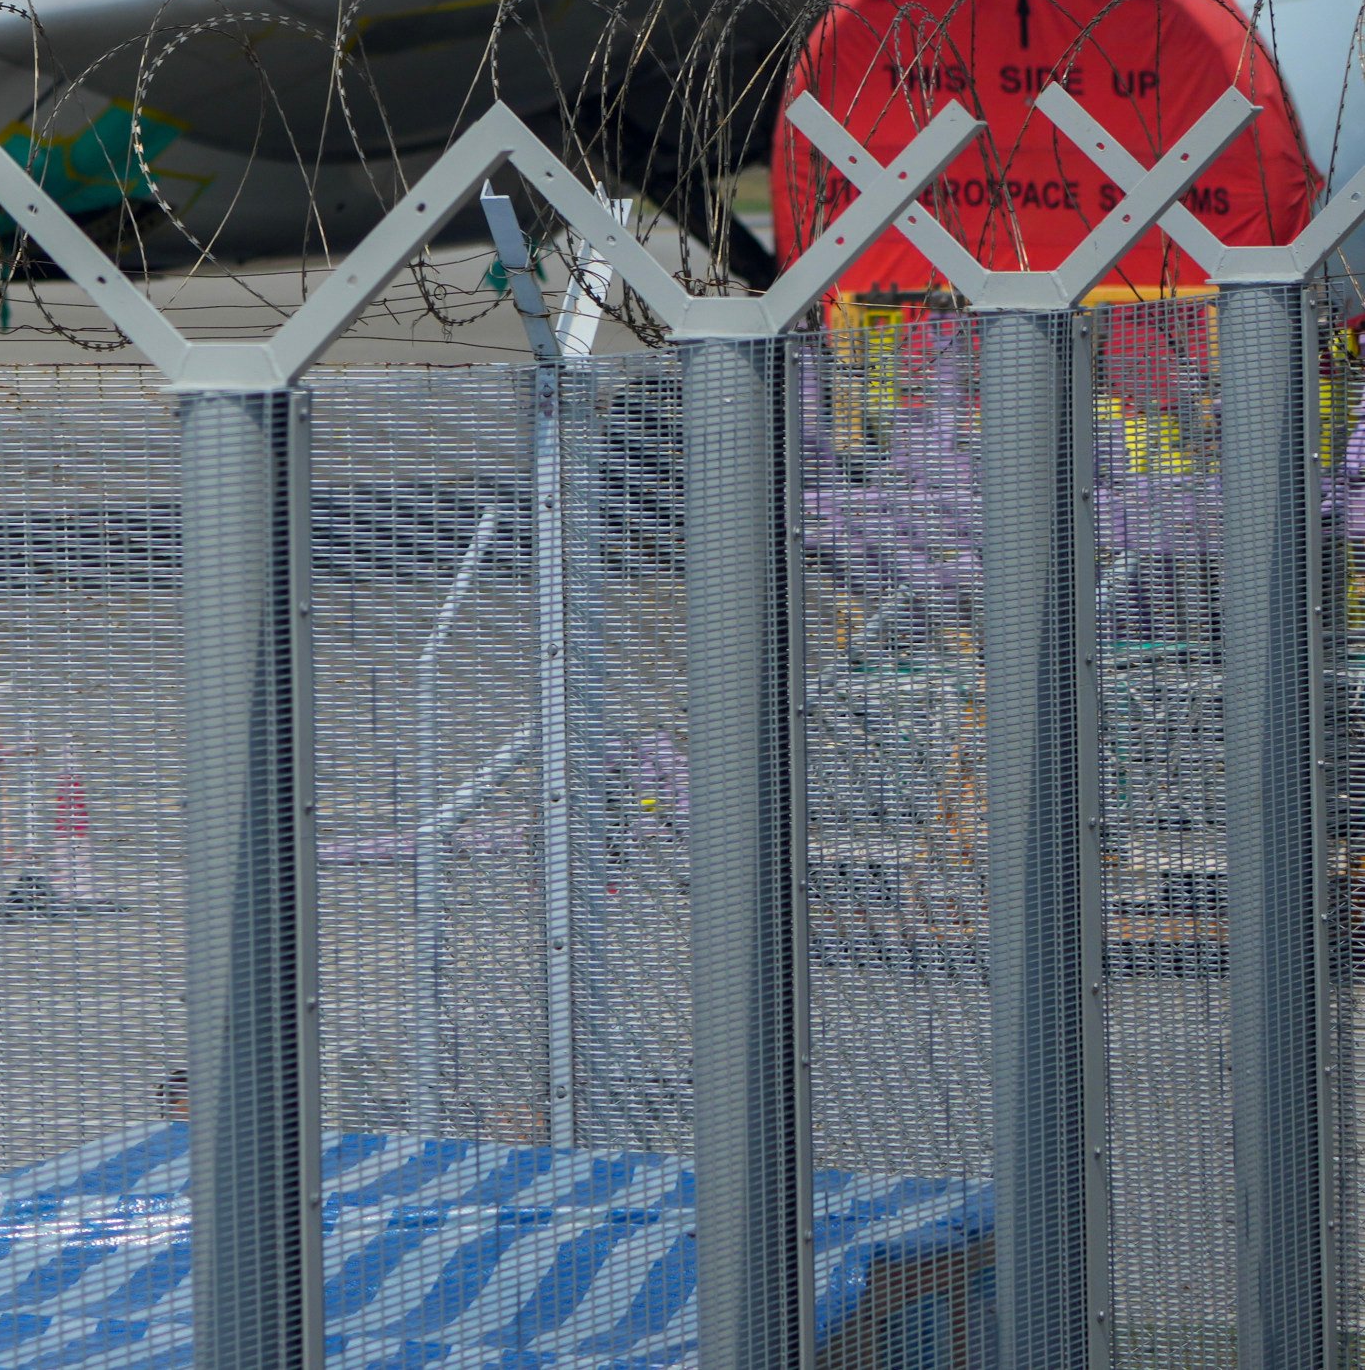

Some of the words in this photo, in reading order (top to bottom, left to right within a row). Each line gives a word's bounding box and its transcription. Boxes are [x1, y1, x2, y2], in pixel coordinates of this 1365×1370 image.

[882, 64, 968, 94] THIS
[1000, 64, 1084, 96] SIDE
[1111, 68, 1160, 98] UP
[915, 179, 1080, 210] EROSPACE
